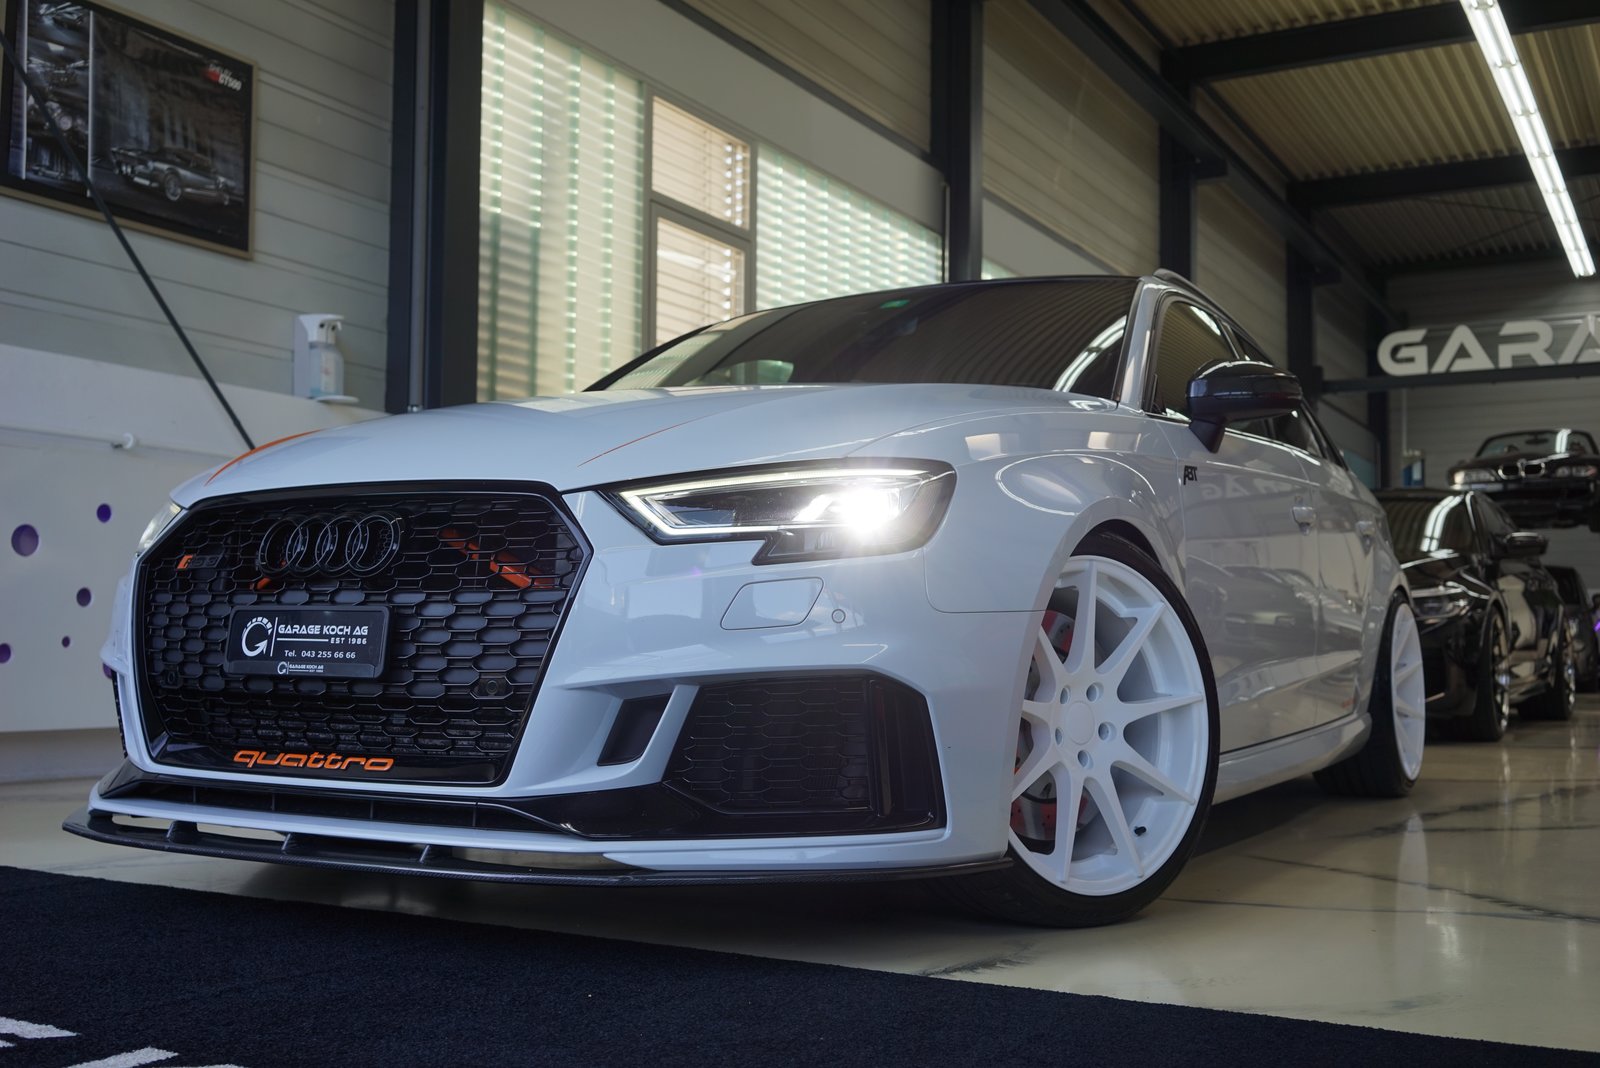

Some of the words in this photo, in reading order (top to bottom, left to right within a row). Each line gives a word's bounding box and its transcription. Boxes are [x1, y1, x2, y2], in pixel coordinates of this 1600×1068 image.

[278, 624, 321, 635] GARAGE
[322, 625, 351, 635] KOCH
[352, 626, 368, 635] AG
[348, 637, 367, 645] 1986
[301, 650, 315, 658] 043
[333, 651, 344, 659] 66
[345, 651, 356, 659] 66
[233, 750, 394, 772] quattro
